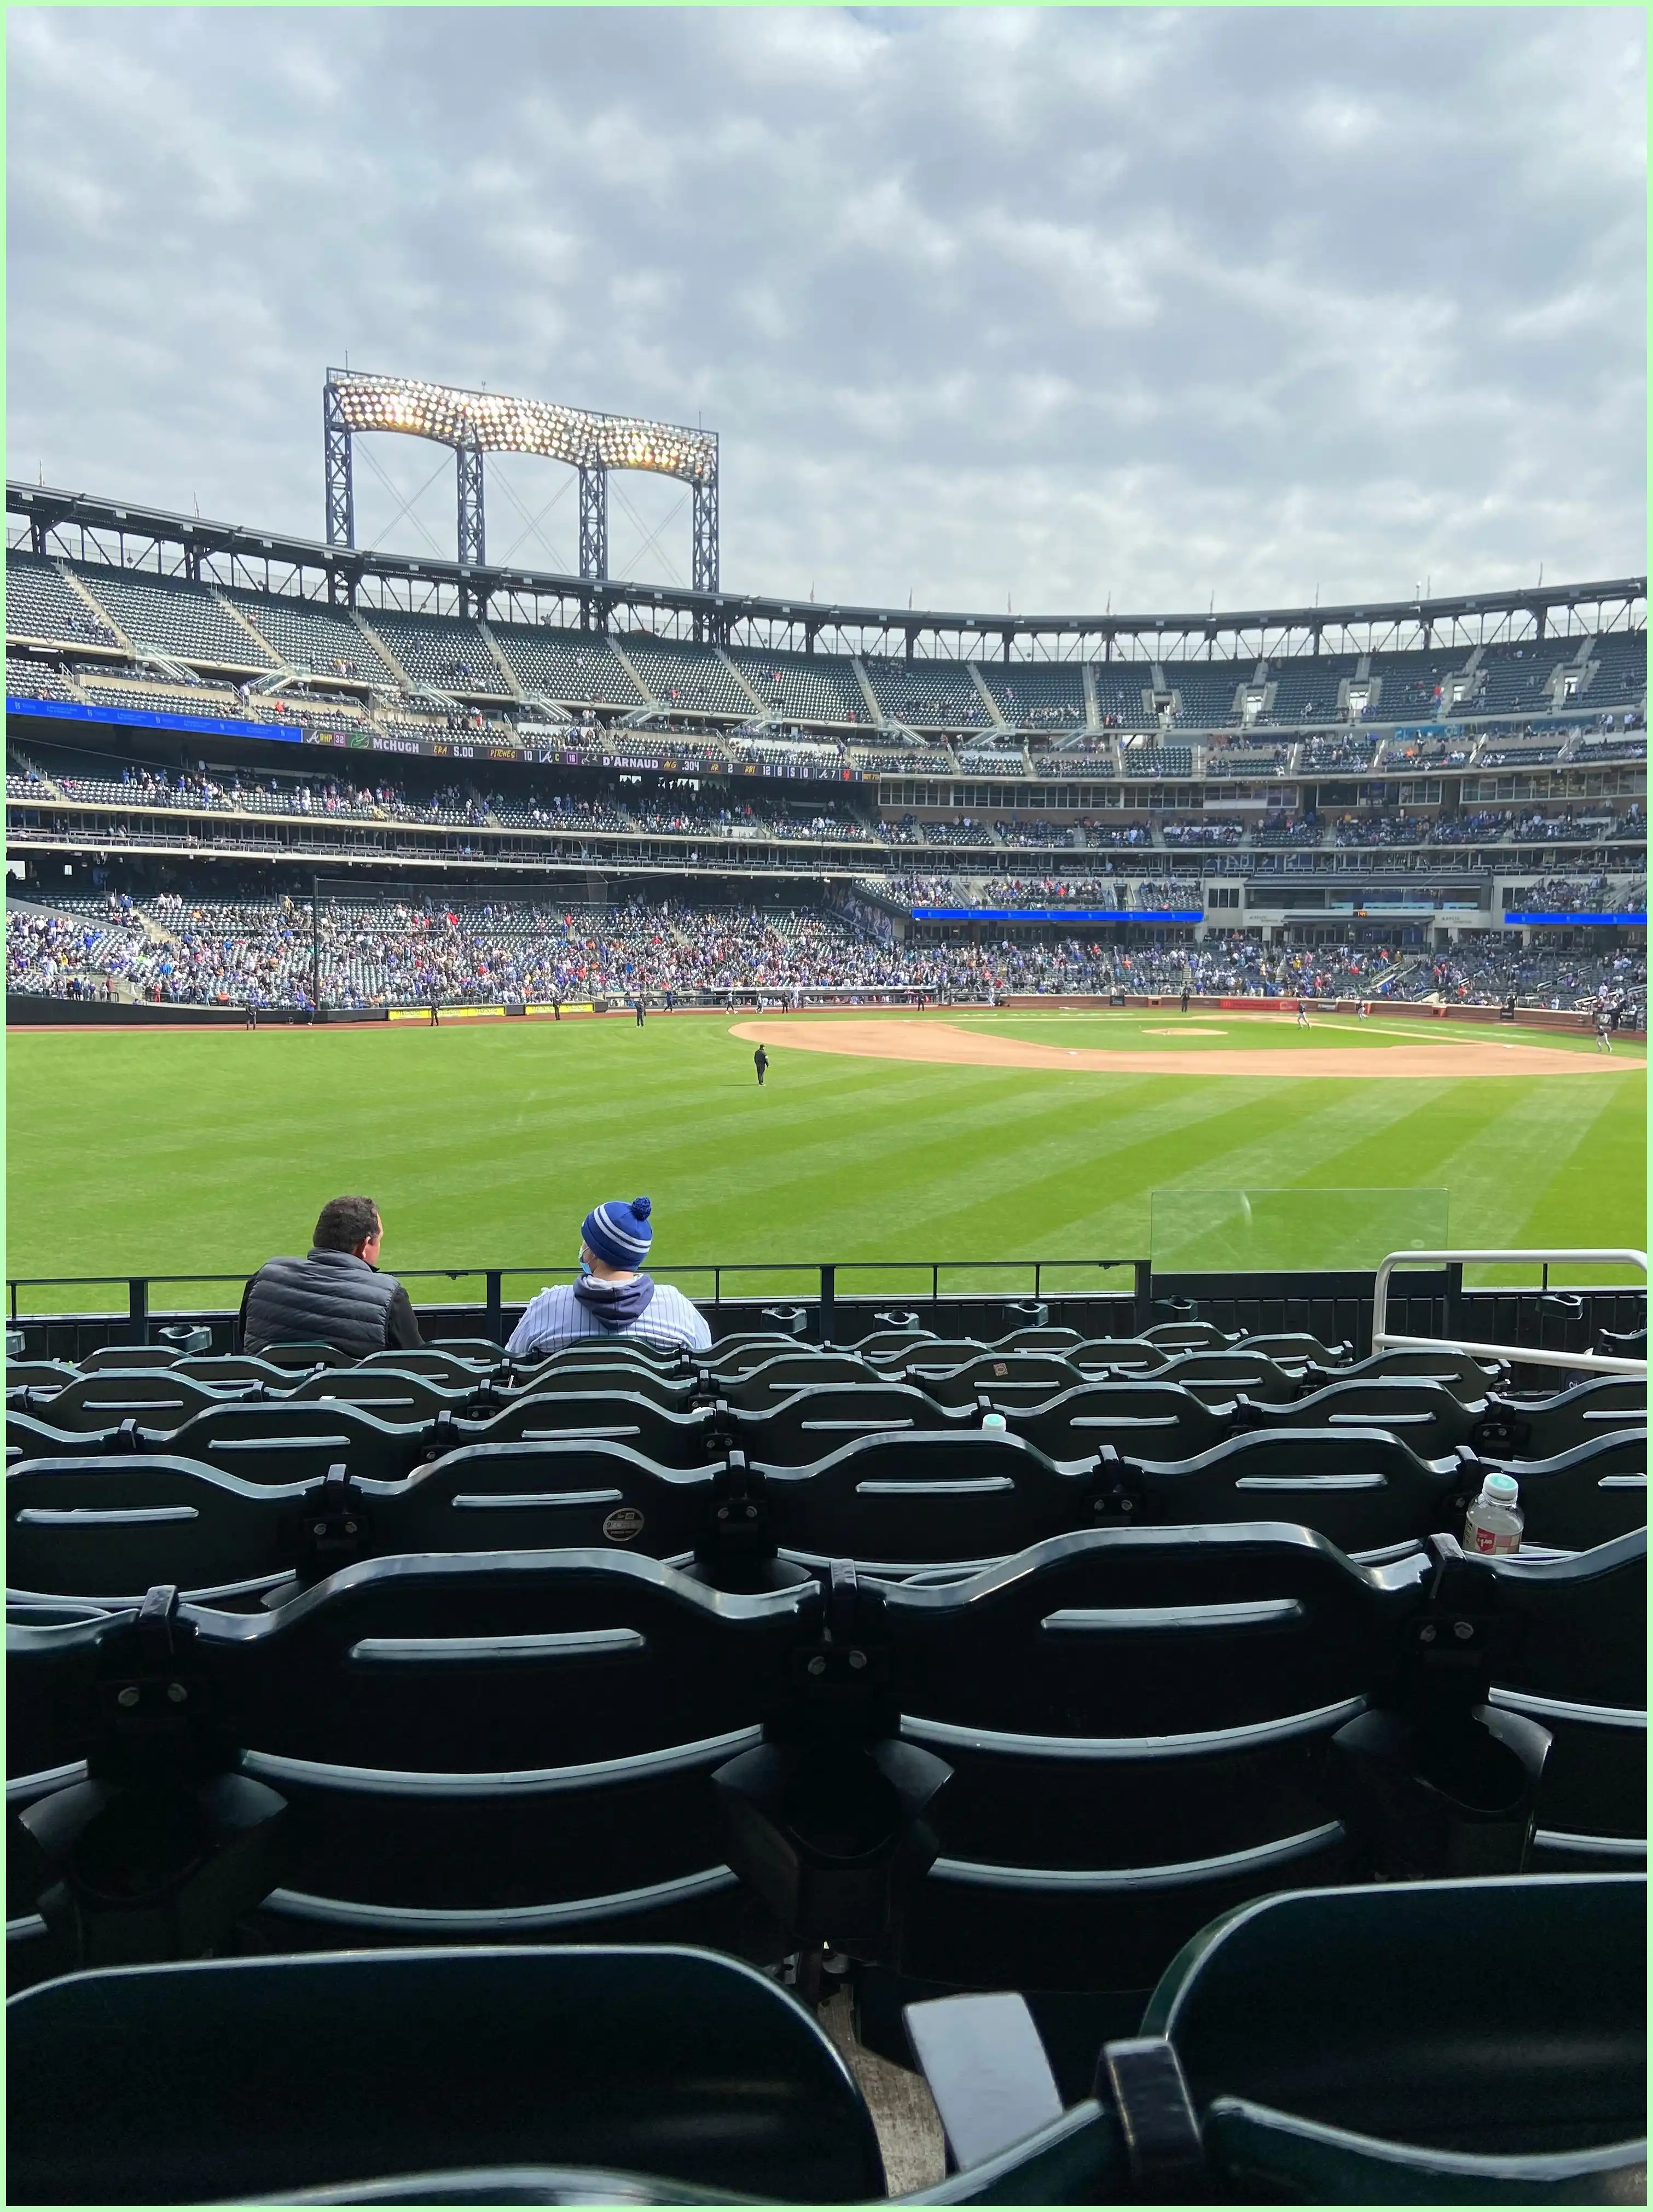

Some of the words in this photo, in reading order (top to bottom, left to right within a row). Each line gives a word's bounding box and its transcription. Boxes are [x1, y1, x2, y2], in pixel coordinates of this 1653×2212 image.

[320, 733, 333, 742] RHP
[335, 735, 345, 744] 32
[433, 745, 448, 754] ERA
[453, 746, 474, 757] 5.00
[490, 749, 515, 759] PITCHES
[524, 750, 532, 761] 10
[554, 753, 560, 762] C
[602, 756, 659, 769] D'ARNAUD
[682, 760, 700, 771] .304
[728, 763, 733, 773] 2
[745, 765, 756, 774] RBI
[763, 765, 770, 775] 12
[831, 770, 836, 779] 7
[855, 771, 859, 780] 1
